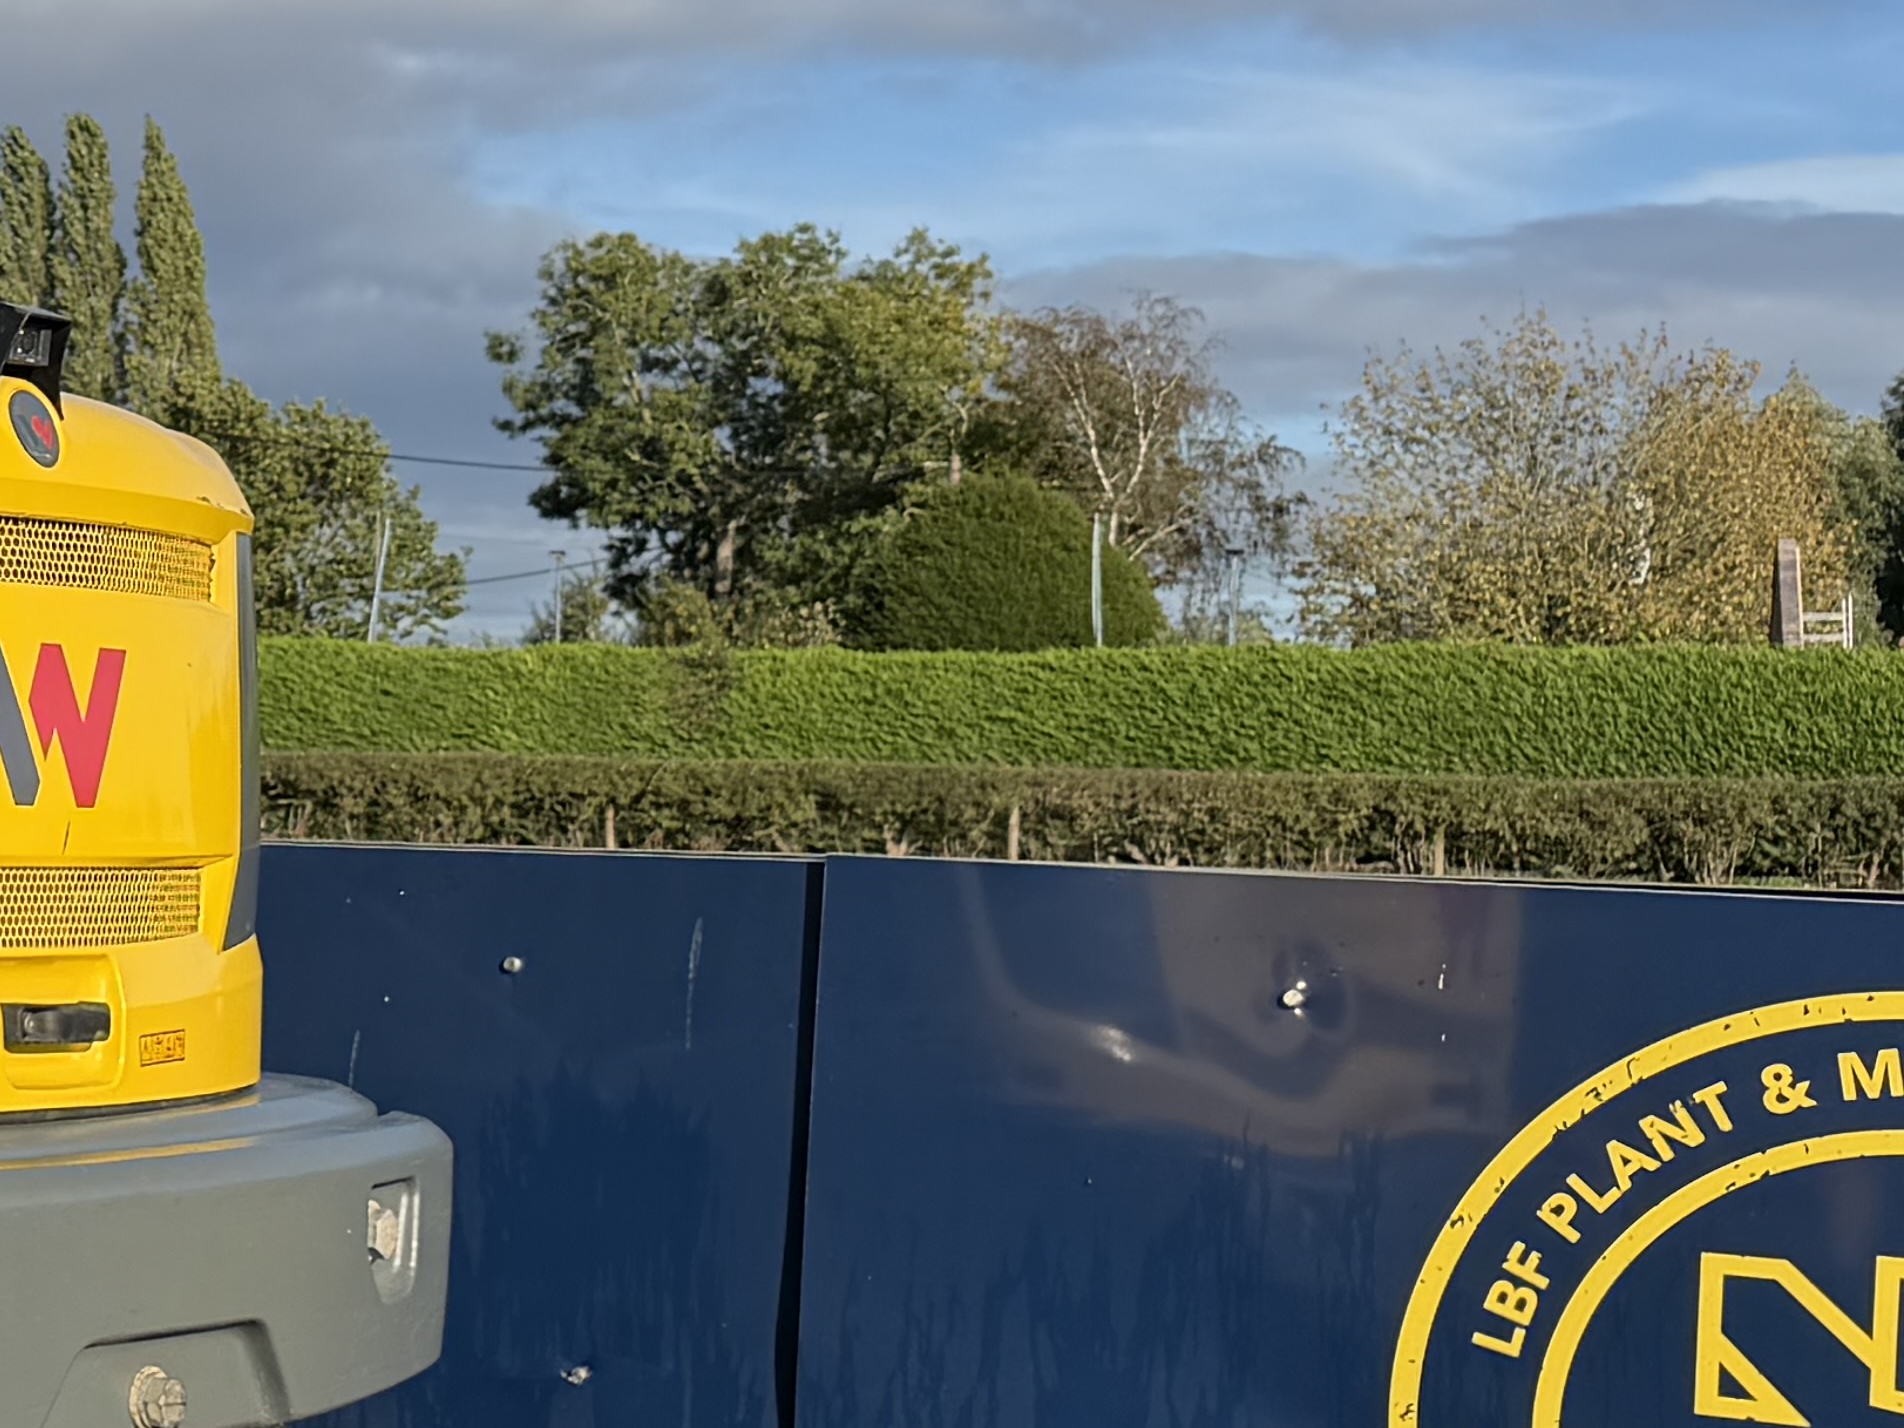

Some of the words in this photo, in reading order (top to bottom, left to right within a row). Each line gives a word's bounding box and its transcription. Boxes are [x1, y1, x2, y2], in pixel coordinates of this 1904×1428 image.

[1471, 1241, 1550, 1359] LBF
[1536, 1080, 1734, 1244] PLANT
[1760, 1063, 1818, 1115] &
